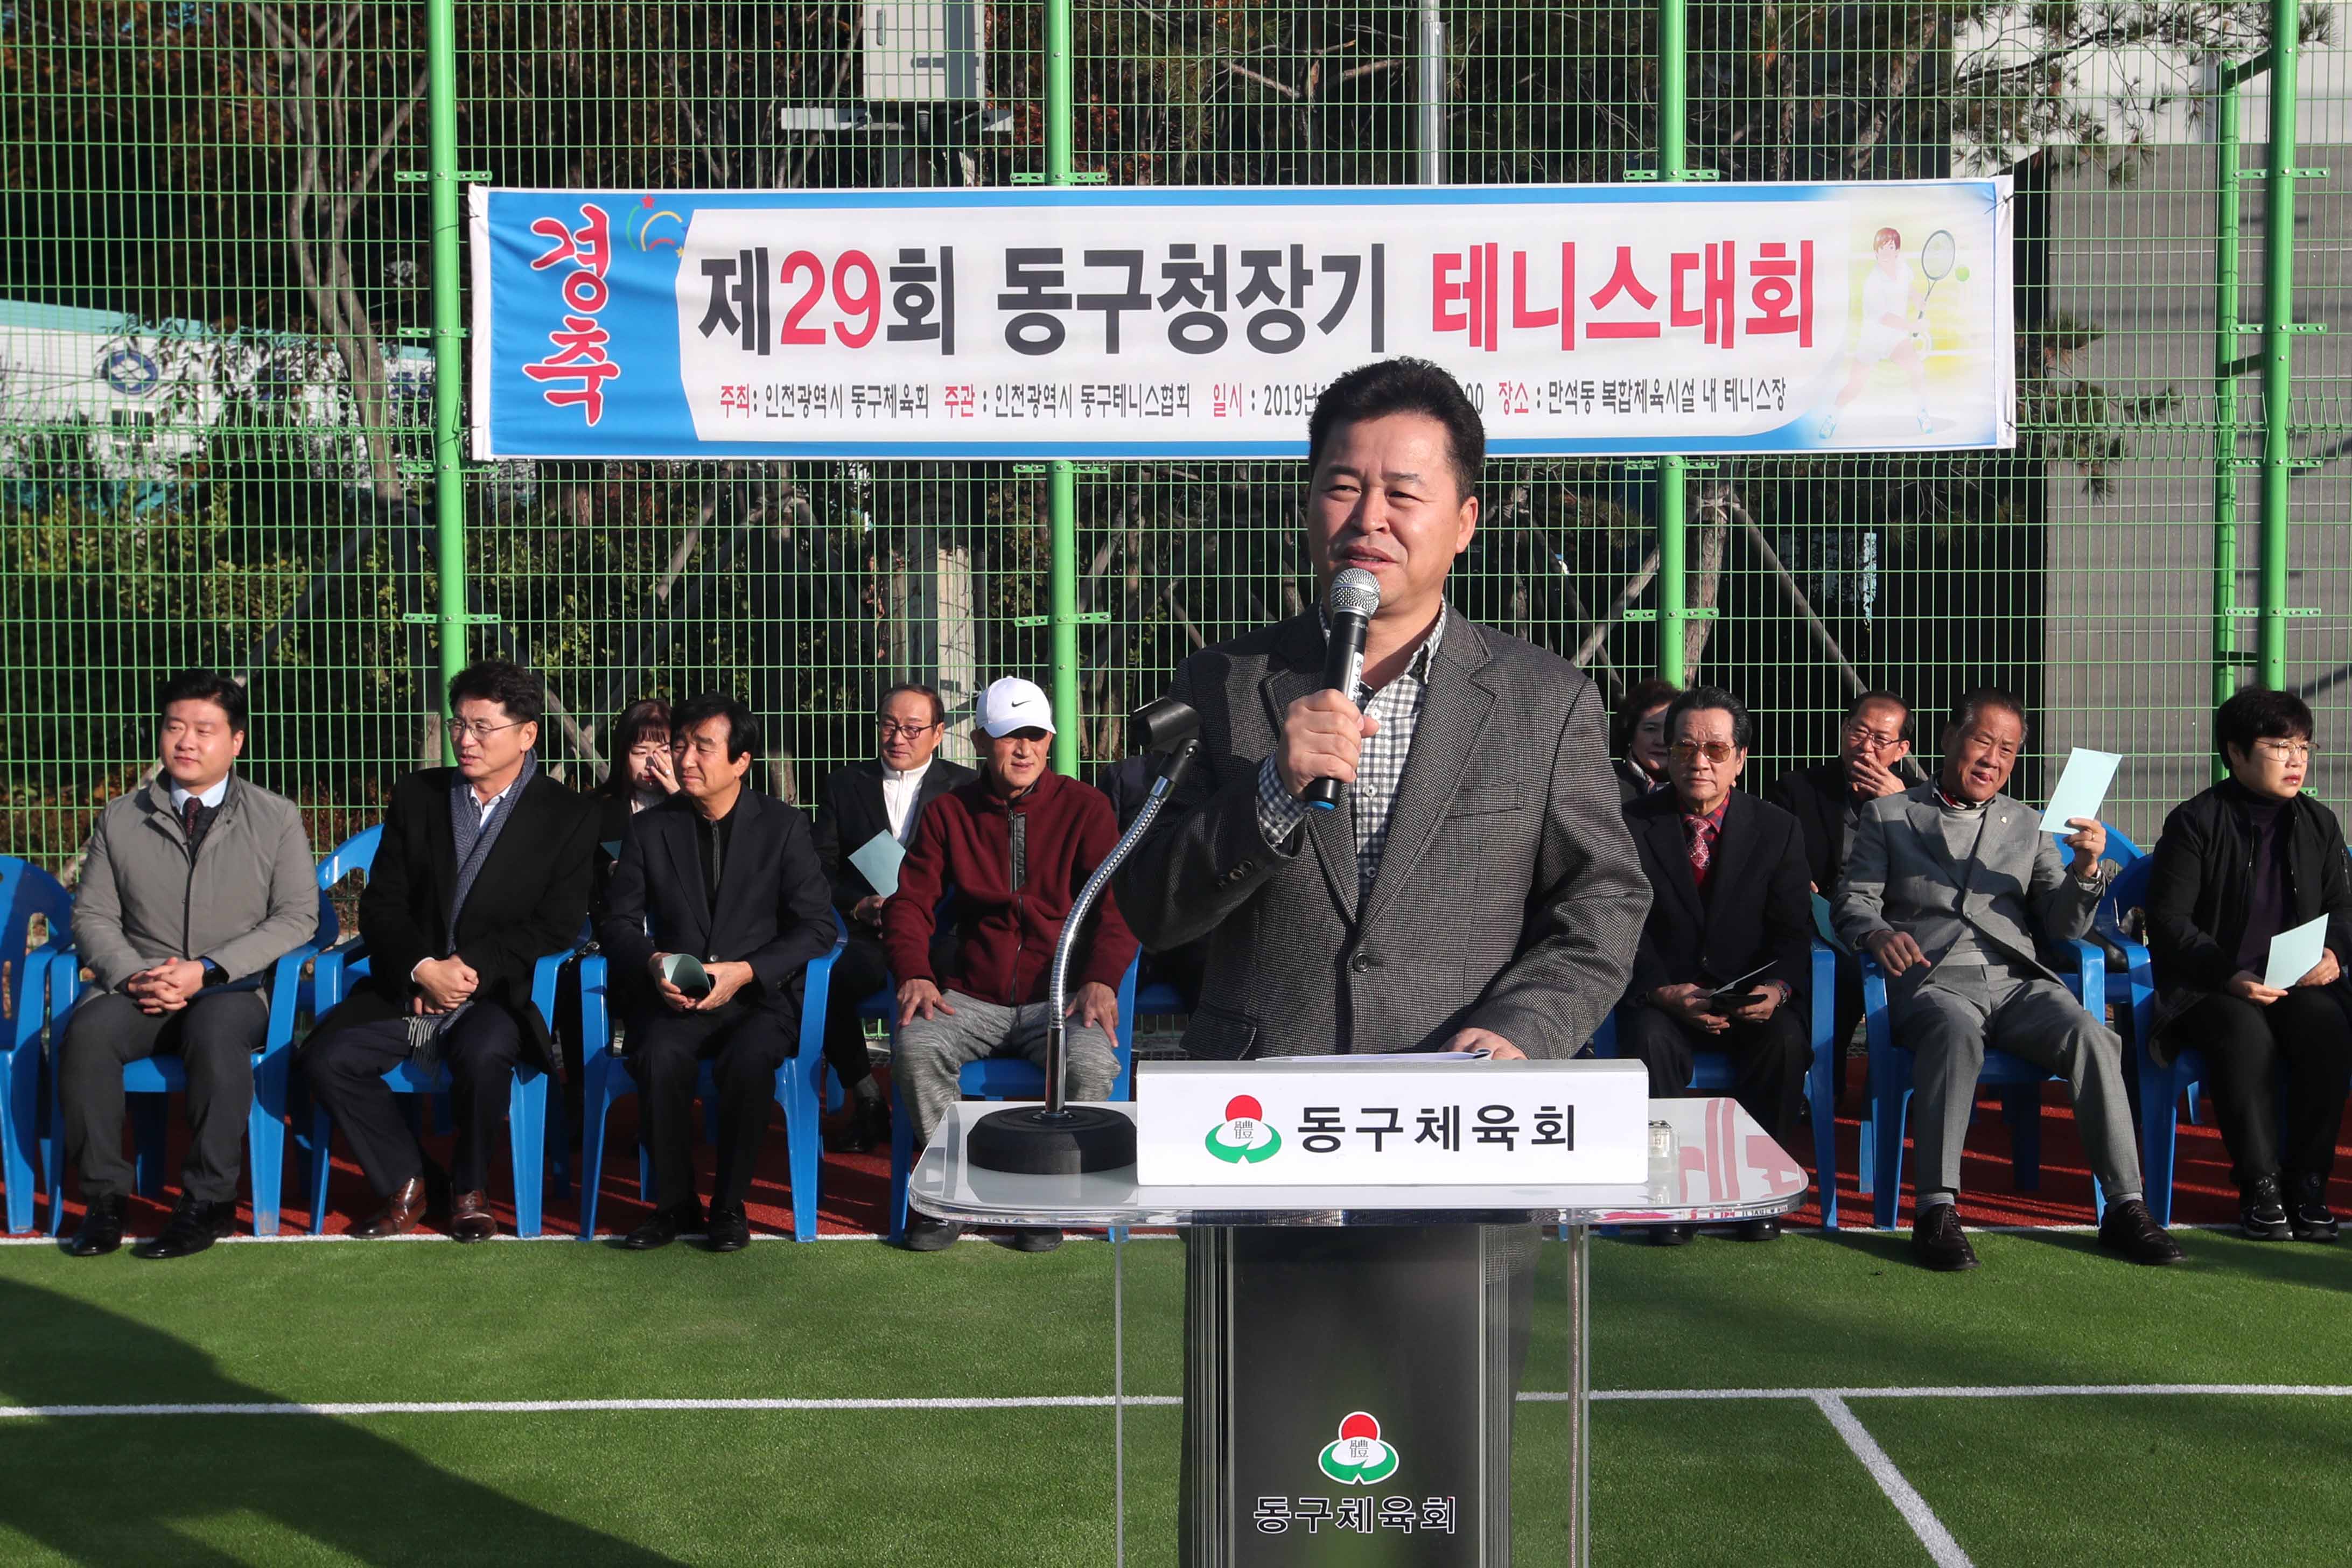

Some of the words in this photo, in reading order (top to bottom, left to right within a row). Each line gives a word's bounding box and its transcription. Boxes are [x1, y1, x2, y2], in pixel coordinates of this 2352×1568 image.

[523, 203, 621, 426] 경축
[698, 246, 955, 356] 제29회
[997, 243, 1385, 356] 동구청장기
[1432, 240, 1814, 352] 테니스대회
[765, 383, 843, 419] 인천광역시
[851, 383, 929, 419] 동구체육회
[995, 383, 1072, 419] 인천광역시
[1081, 382, 1190, 418] 동구테니스협회
[1549, 379, 1595, 415] 만석동
[1601, 378, 1695, 415] 복합체육시설
[1703, 377, 1717, 412] 내
[1724, 376, 1786, 412] 테니스장
[1297, 1104, 1574, 1154] 동구체육회
[1254, 1496, 1455, 1534] 동구체육회
